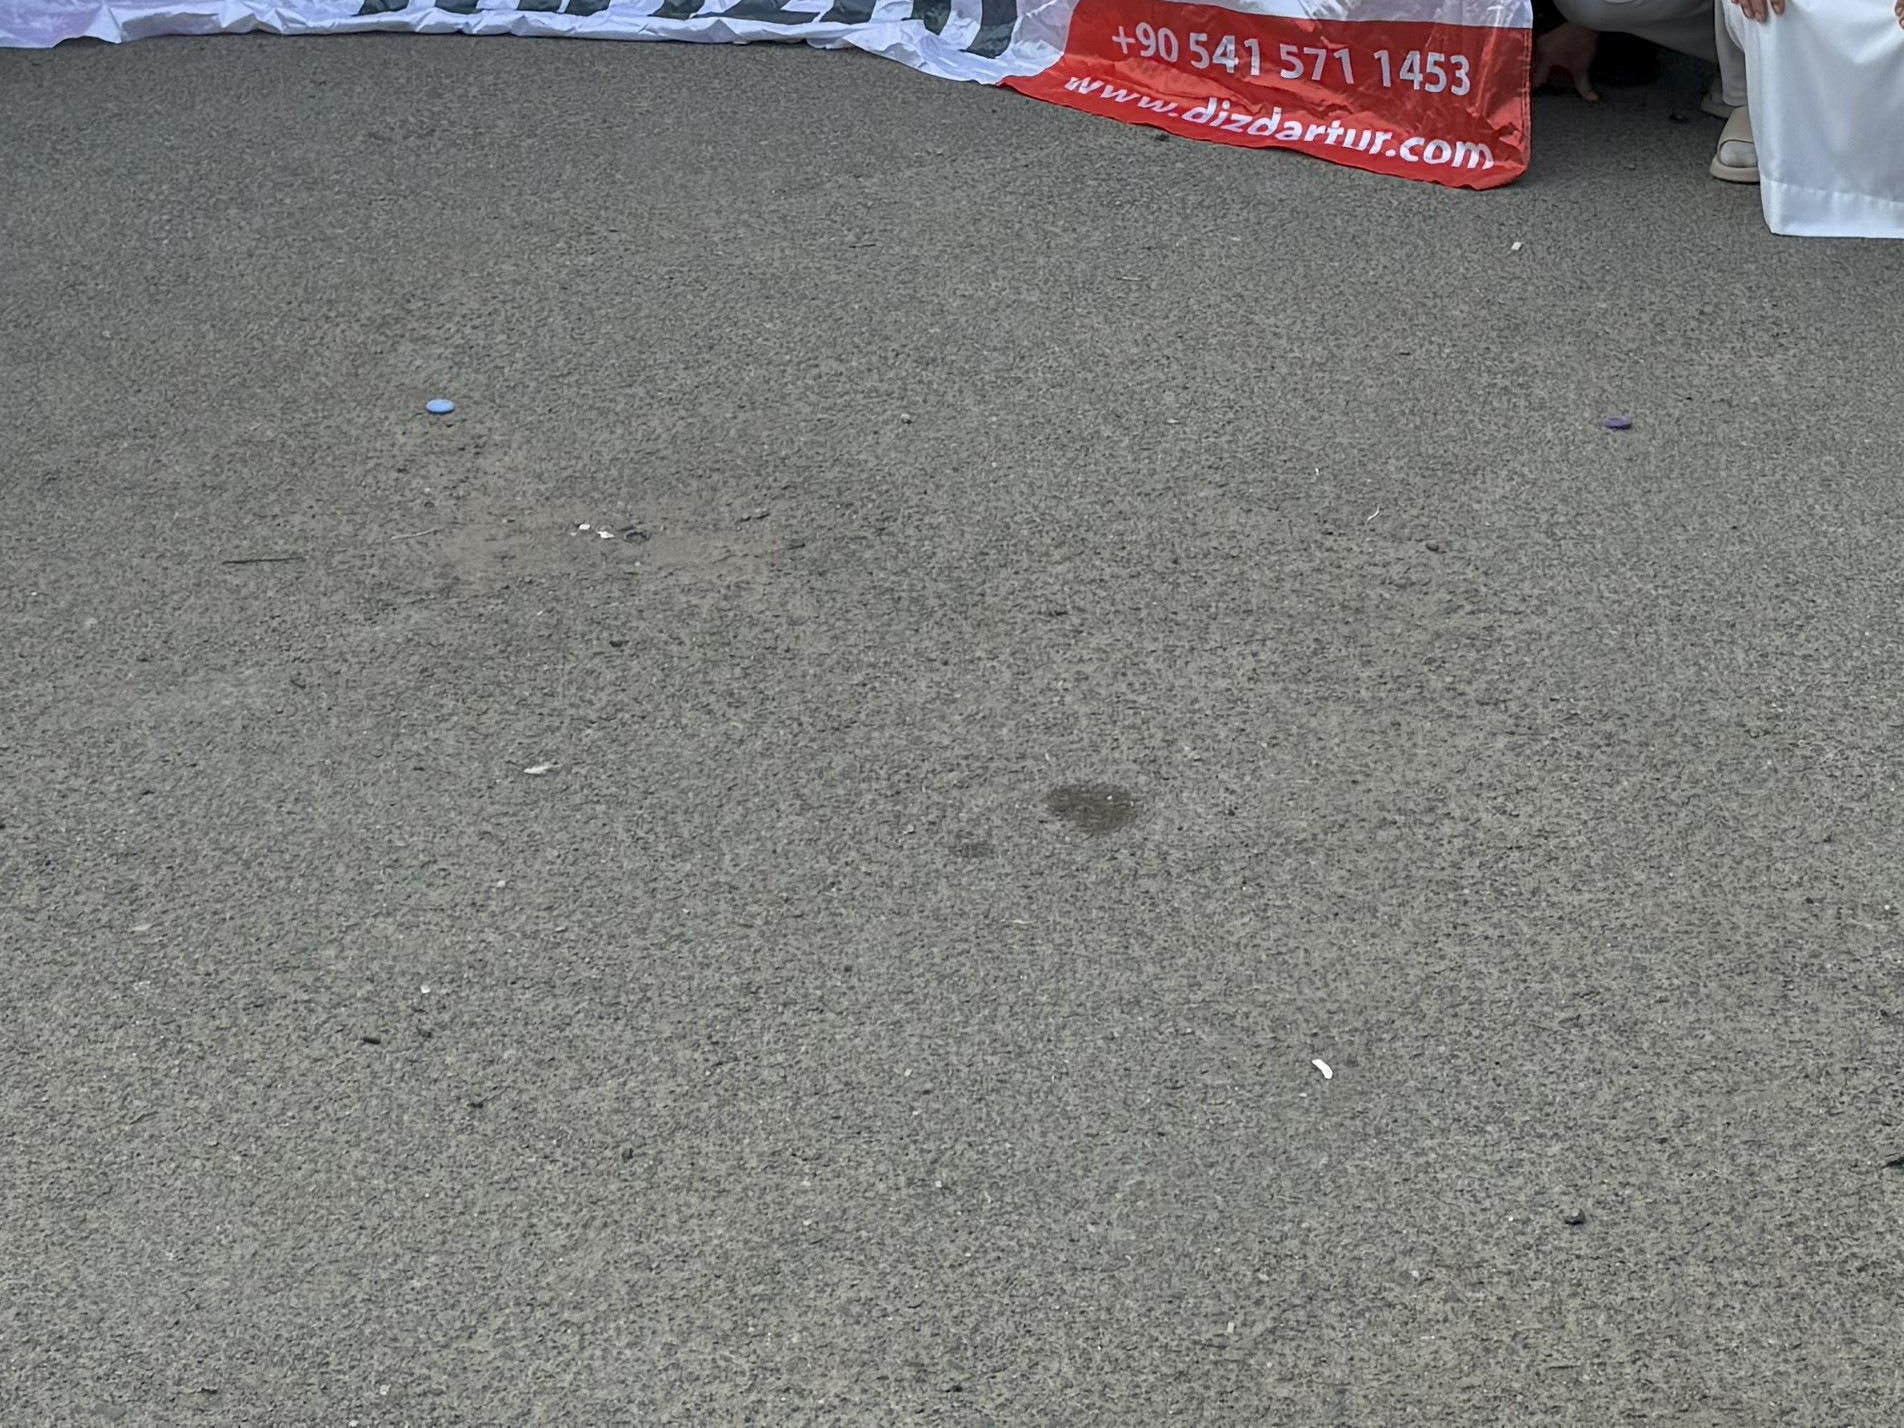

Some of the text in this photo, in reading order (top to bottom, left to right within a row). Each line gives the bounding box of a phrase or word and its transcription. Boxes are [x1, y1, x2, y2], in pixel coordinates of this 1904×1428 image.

[1111, 21, 1472, 96] +90 541 571 1453
[1064, 75, 1495, 170] www.dizdartur.com
